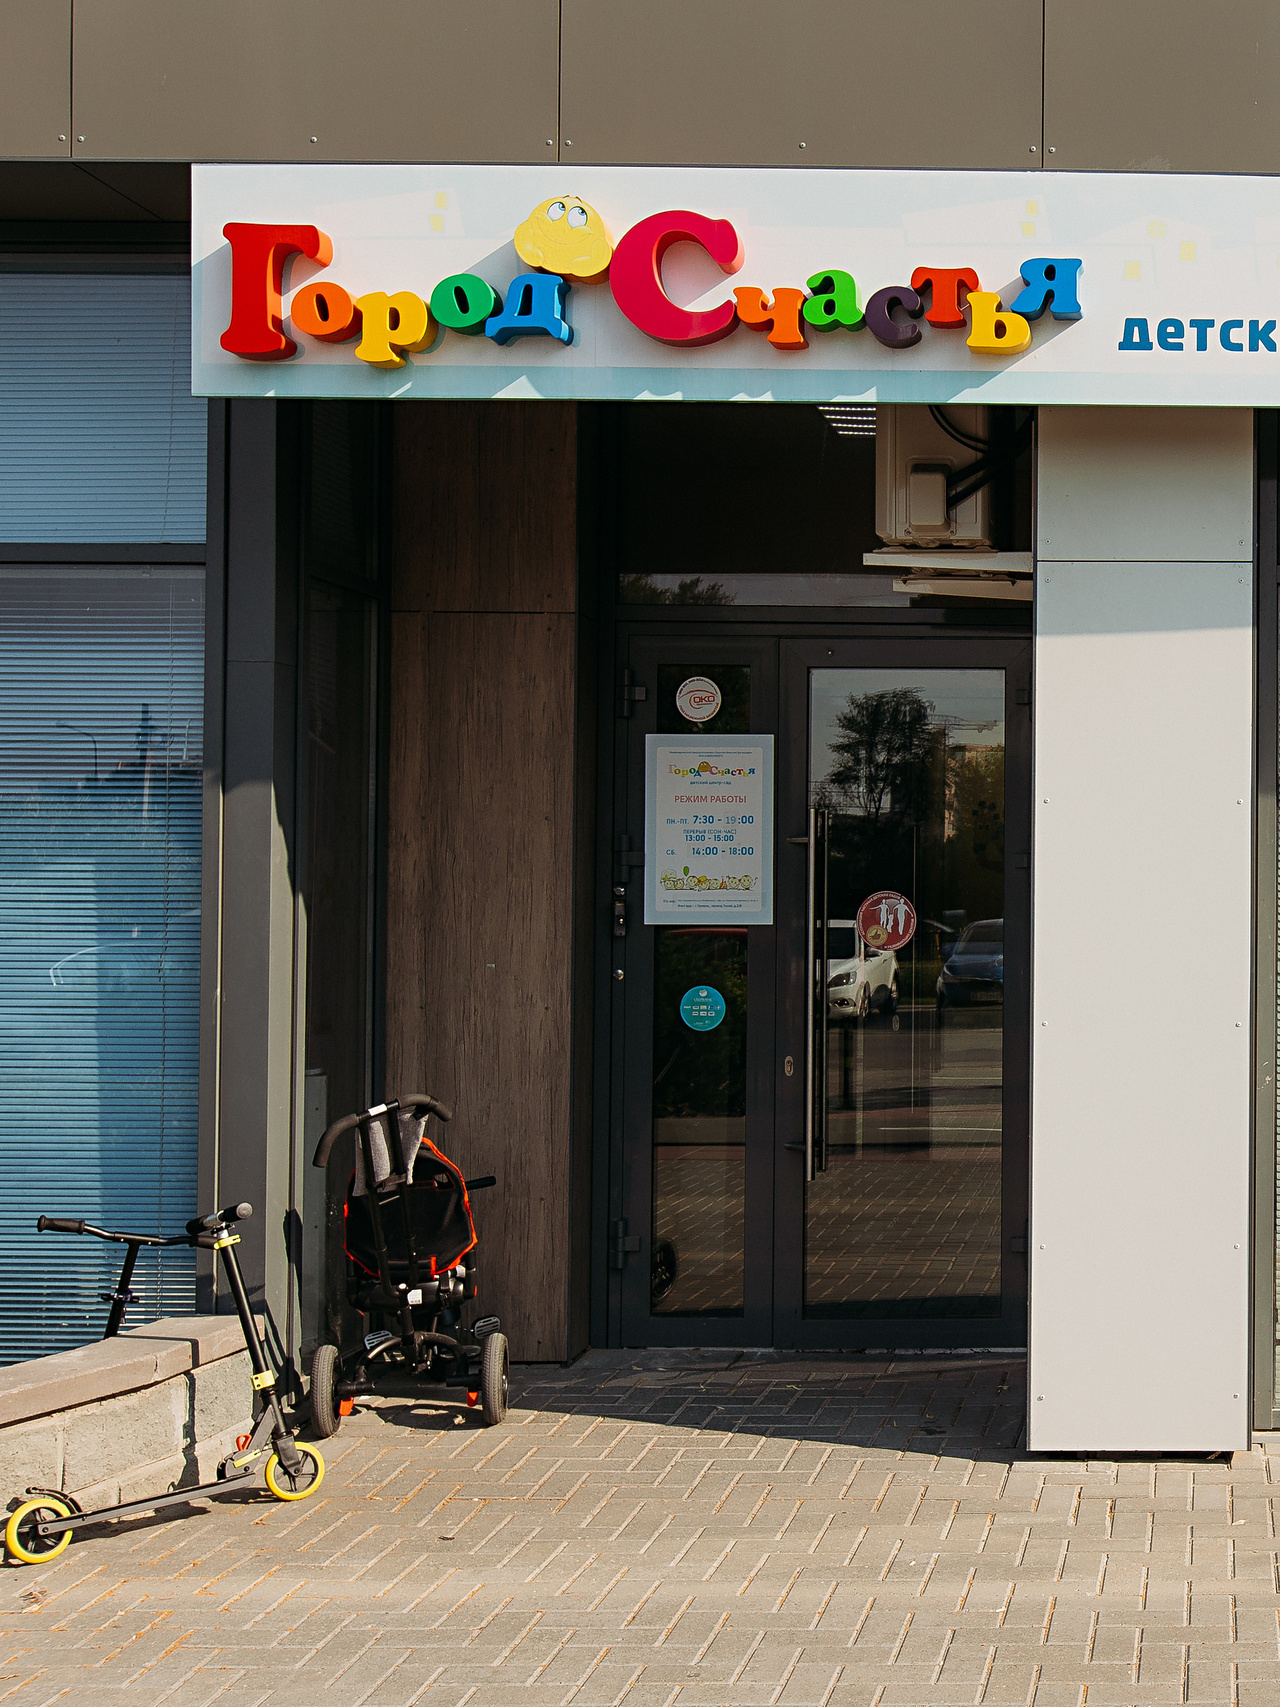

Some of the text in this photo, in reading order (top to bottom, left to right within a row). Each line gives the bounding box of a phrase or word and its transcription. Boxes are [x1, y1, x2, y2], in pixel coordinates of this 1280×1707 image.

[220, 209, 1083, 369] Город Счастья
[668, 764, 755, 777] Город Счастья
[674, 795, 747, 803] РЕЖИМ РАБОТЫ
[693, 815, 714, 824] 7:30
[692, 846, 718, 855] 14:00
[729, 846, 754, 855] 18:00
